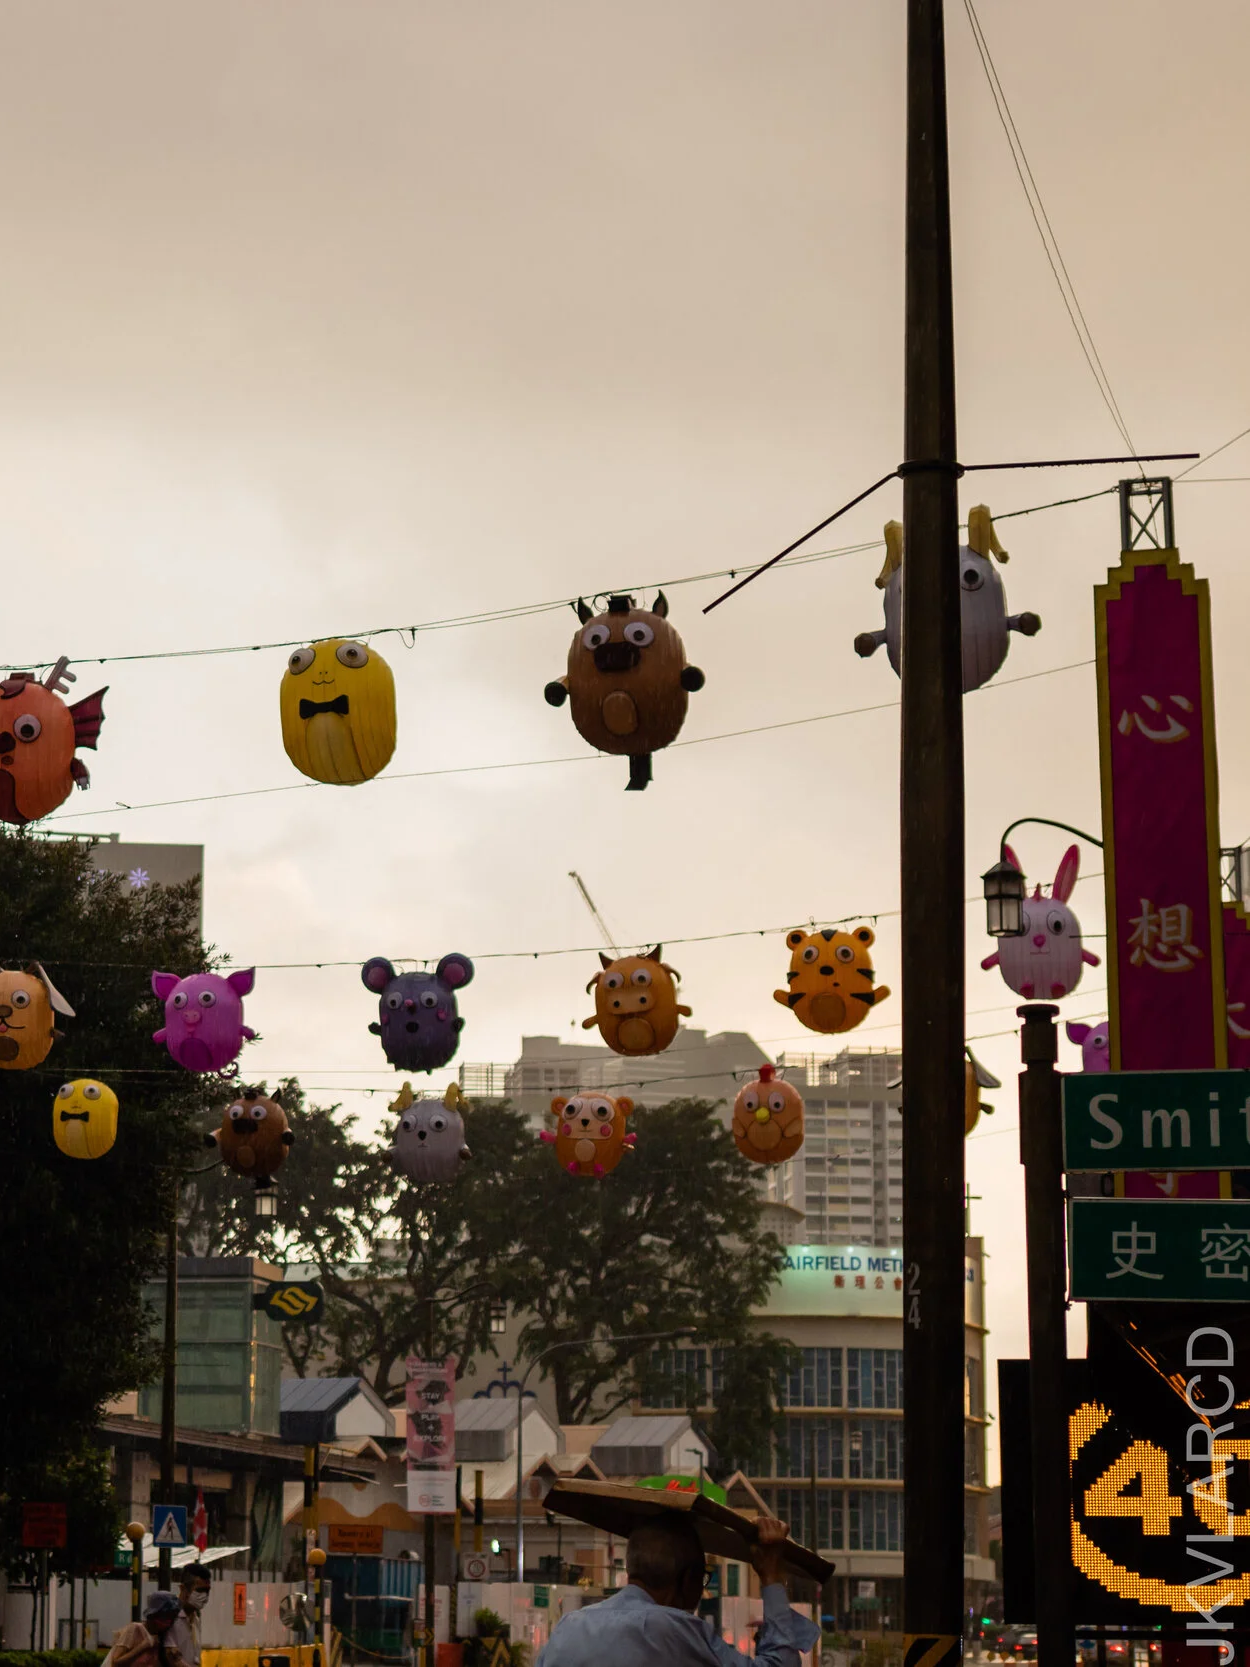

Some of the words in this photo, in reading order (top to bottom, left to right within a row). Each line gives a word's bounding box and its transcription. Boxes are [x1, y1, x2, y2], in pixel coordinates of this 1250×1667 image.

[868, 1257, 904, 1272] MET
[1105, 1220, 1250, 1283] 史密
[907, 1261, 922, 1330] 24
